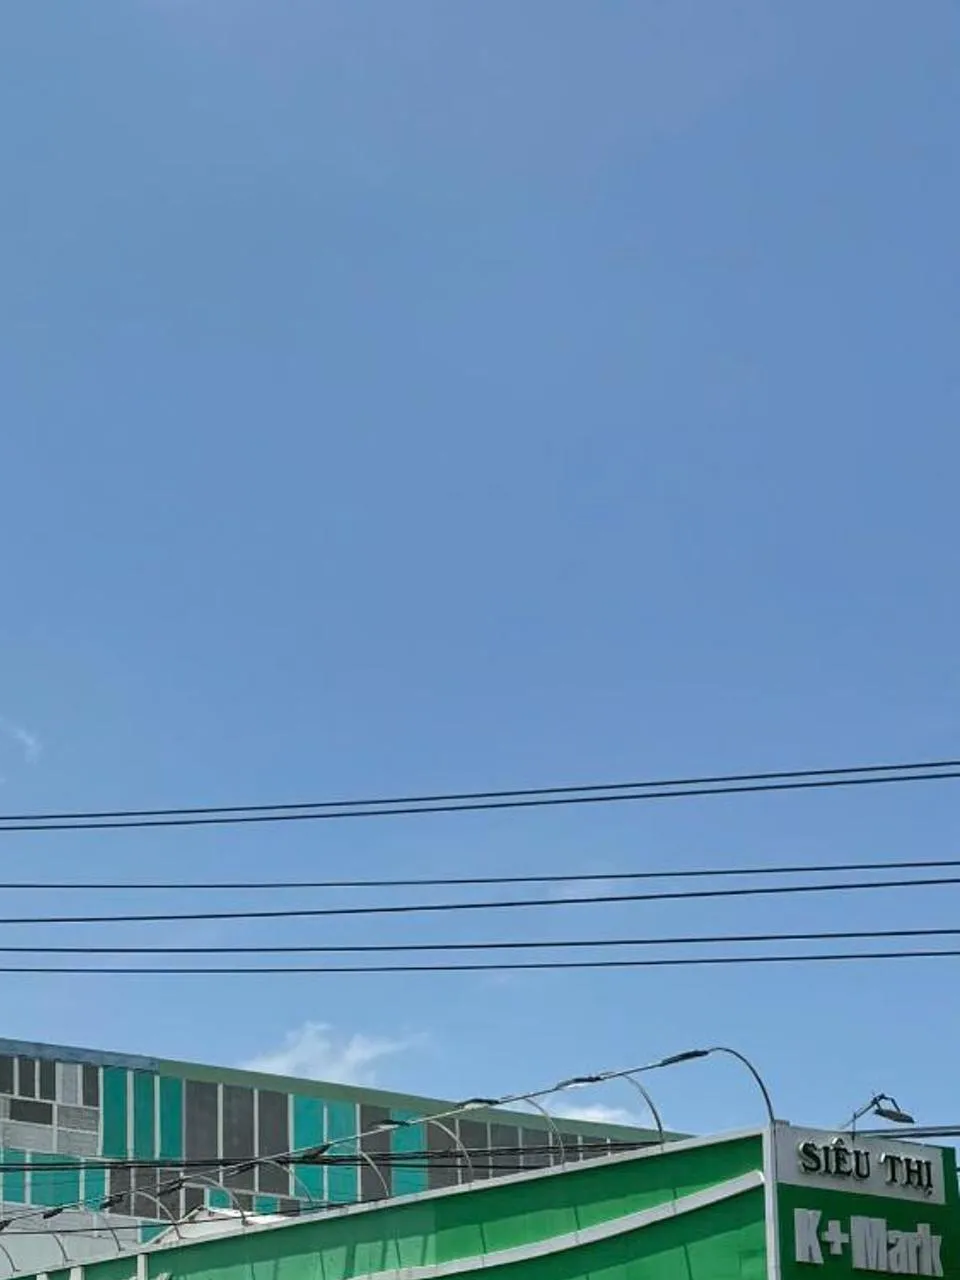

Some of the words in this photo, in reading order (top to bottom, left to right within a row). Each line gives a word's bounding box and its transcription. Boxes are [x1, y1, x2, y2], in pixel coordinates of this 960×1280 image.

[799, 1138, 870, 1180] SIÊU
[879, 1153, 933, 1196] THỊ
[794, 1208, 944, 1277] K+Mark
